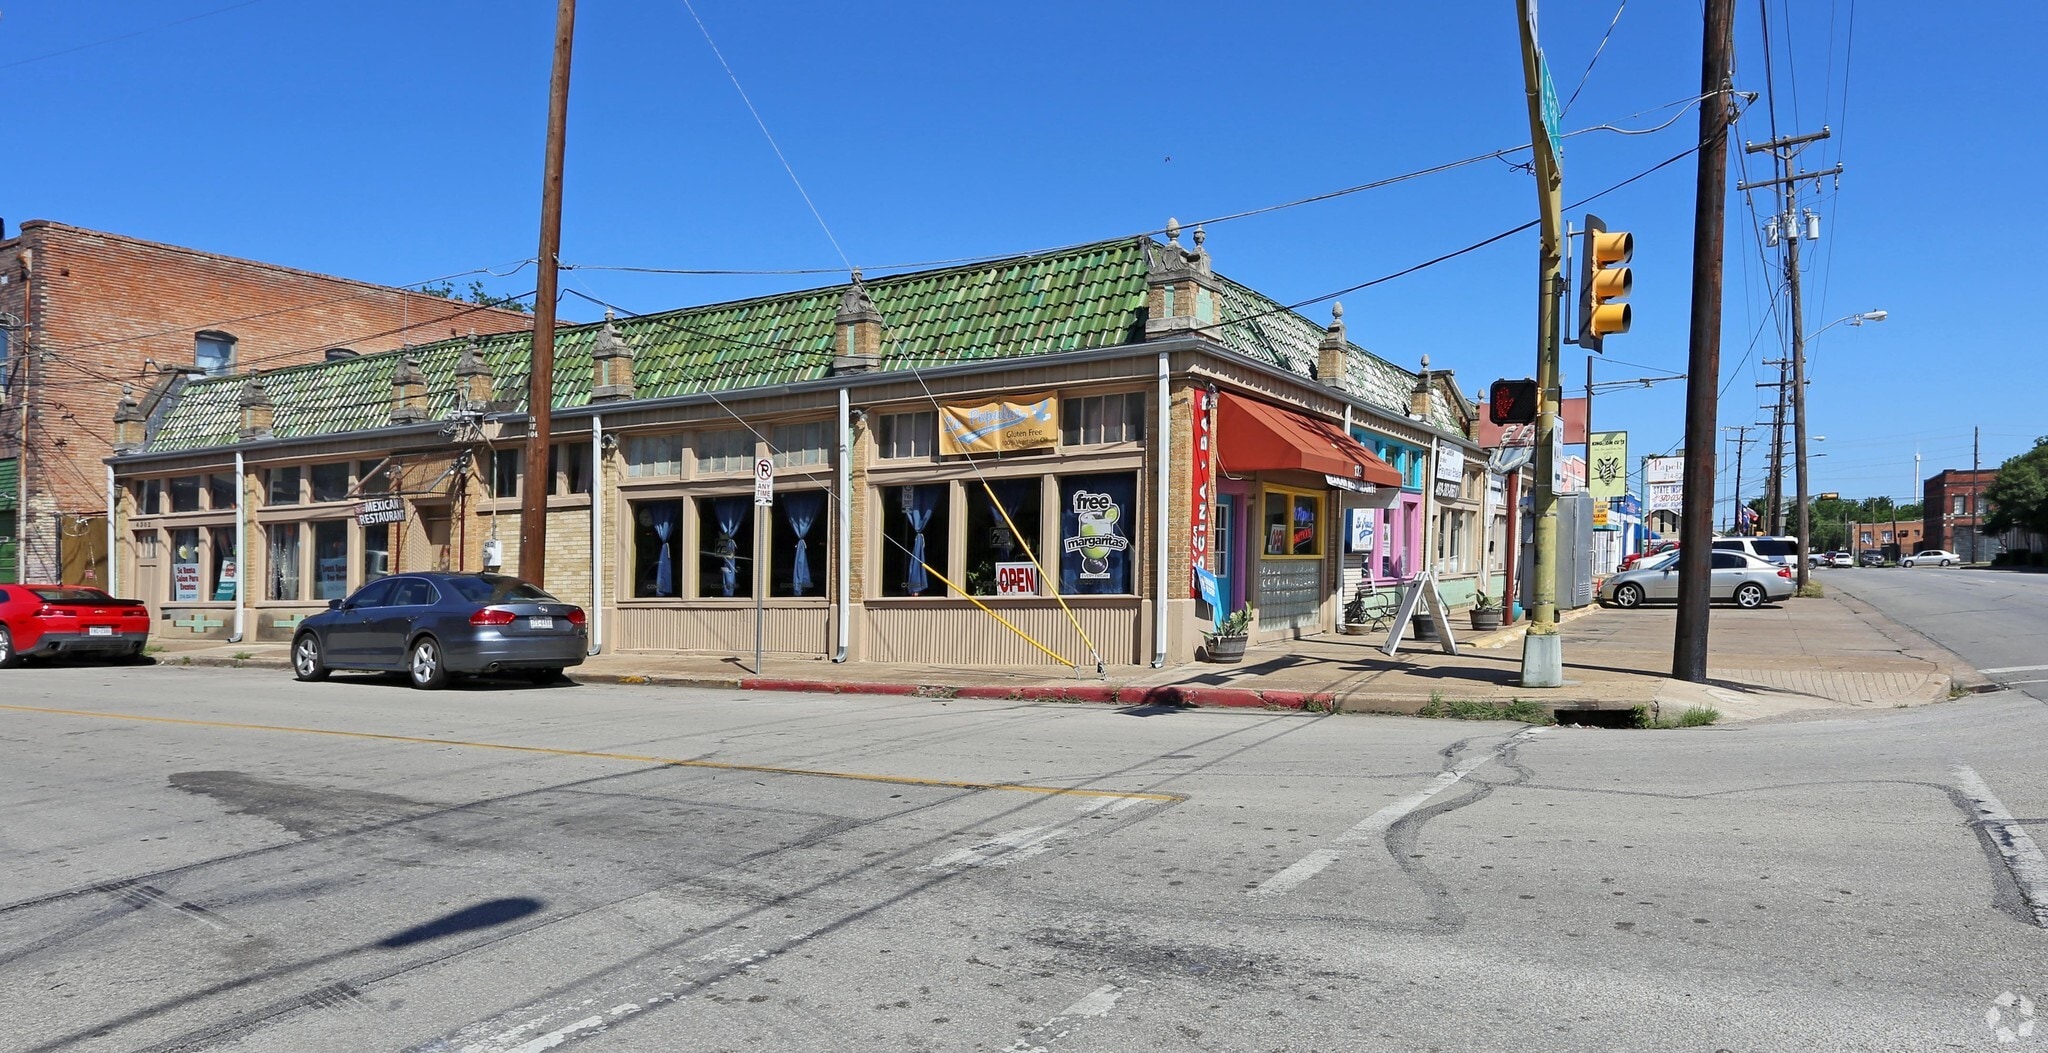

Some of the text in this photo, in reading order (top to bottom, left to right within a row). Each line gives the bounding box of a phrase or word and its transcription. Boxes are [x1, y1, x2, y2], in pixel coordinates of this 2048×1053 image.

[1028, 429, 1042, 437] Free
[1652, 485, 1681, 494] STATE INSP
[365, 499, 399, 513] MEXICAN
[1076, 494, 1109, 510] free
[359, 509, 404, 525] RESTAURANT
[1067, 534, 1126, 549] margaritas
[1000, 567, 1034, 593] OPEN
